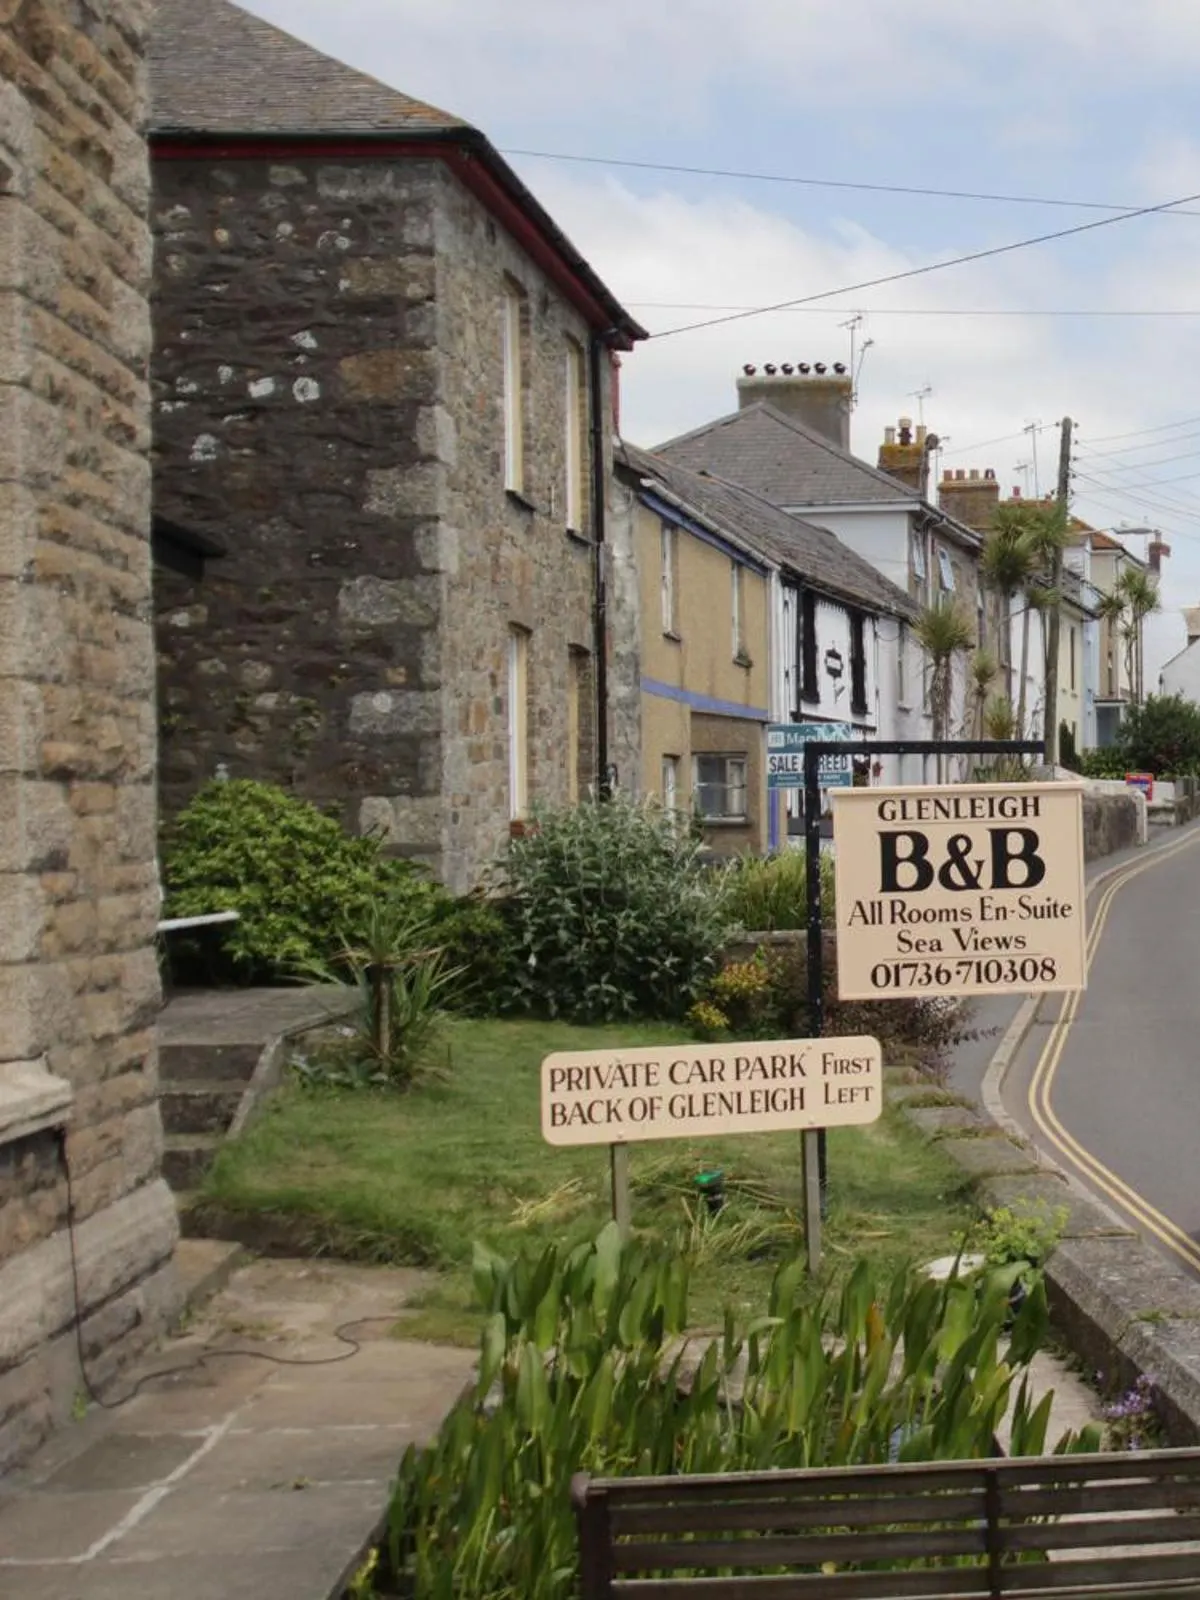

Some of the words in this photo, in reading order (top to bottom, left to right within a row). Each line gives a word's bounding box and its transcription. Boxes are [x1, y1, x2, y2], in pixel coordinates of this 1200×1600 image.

[769, 755, 798, 772] SALE
[877, 796, 1040, 821] GLENLEIGH
[877, 827, 1046, 893] B&B
[848, 900, 882, 926] All
[890, 899, 972, 925] Rooms
[979, 895, 1072, 921] En-Suite
[897, 931, 942, 953] Sea
[952, 927, 1027, 951] Views
[550, 1062, 660, 1092] PRIVATE
[668, 1059, 725, 1085] CAR
[734, 1053, 807, 1080] PARK
[550, 1097, 622, 1127] BACK
[629, 1095, 663, 1121] OF
[669, 1086, 805, 1120] GLENLEIGH
